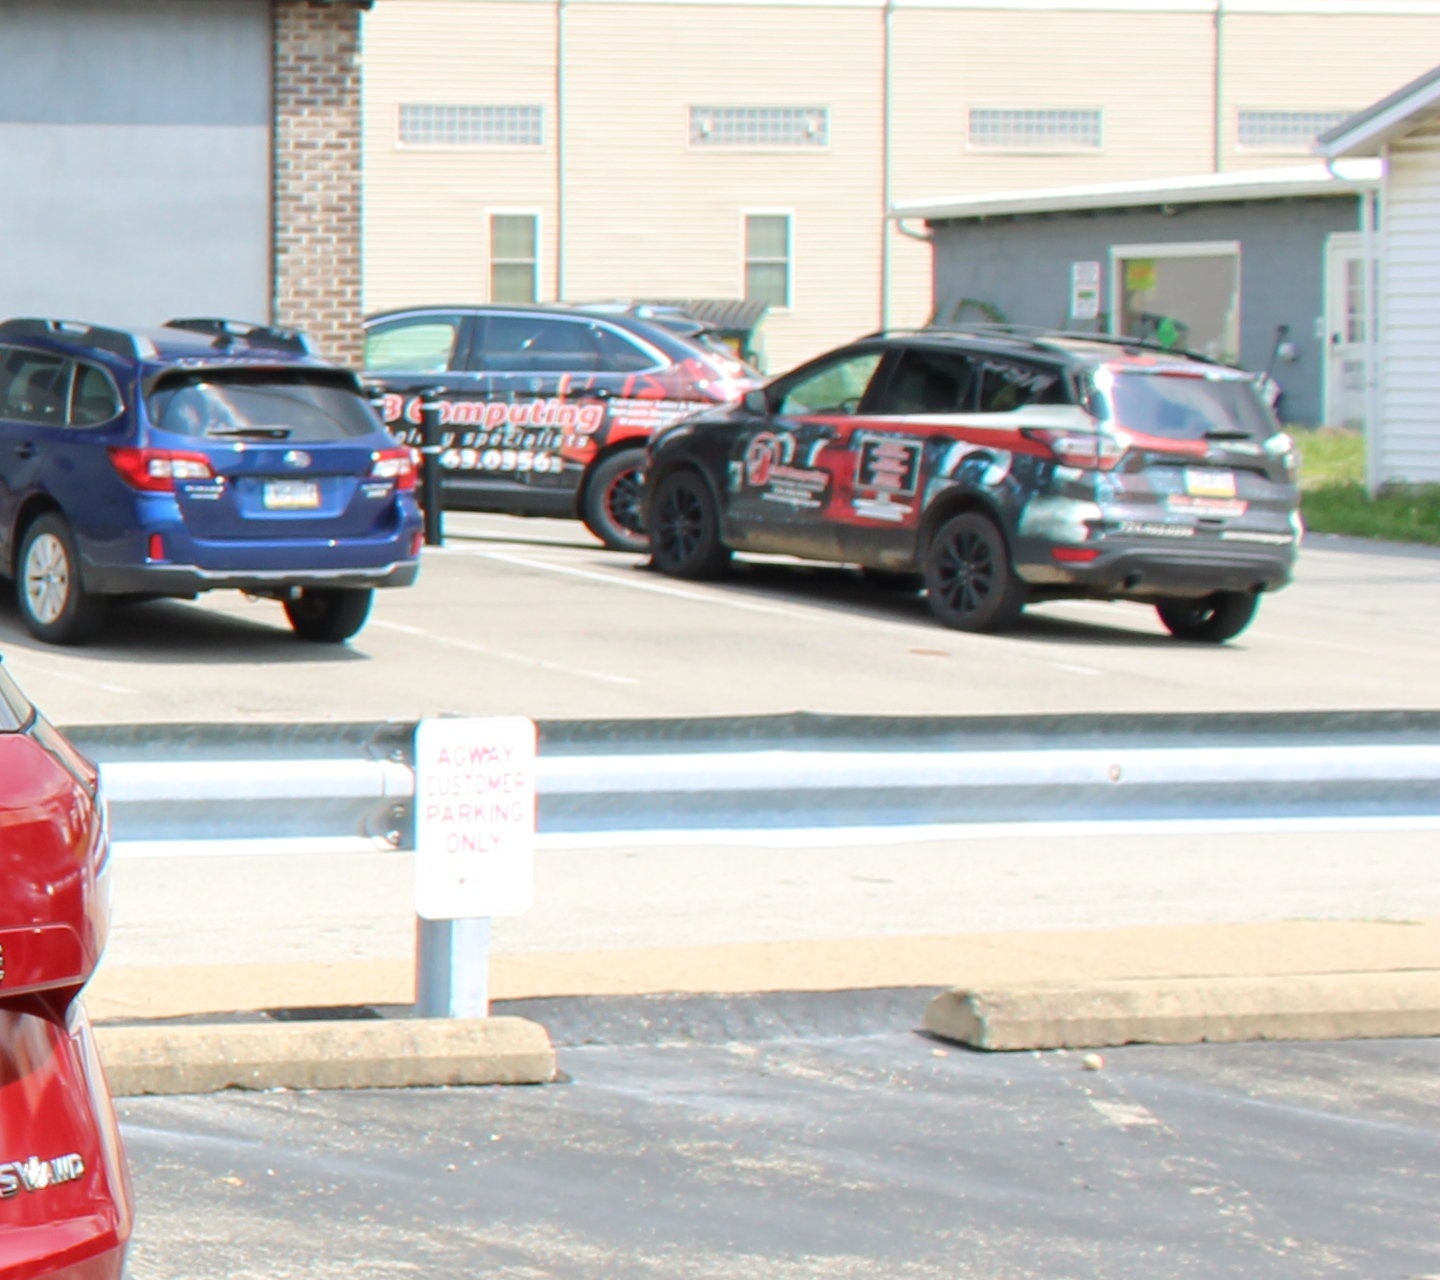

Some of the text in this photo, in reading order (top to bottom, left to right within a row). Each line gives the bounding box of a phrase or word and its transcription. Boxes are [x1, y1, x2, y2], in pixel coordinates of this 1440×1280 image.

[461, 428, 590, 451] specialists
[438, 449, 553, 473] 63.0356
[437, 744, 515, 768] AGWAY
[425, 772, 525, 797] CUSTOMER
[425, 801, 524, 825] PARKING
[446, 831, 503, 854] ONLY
